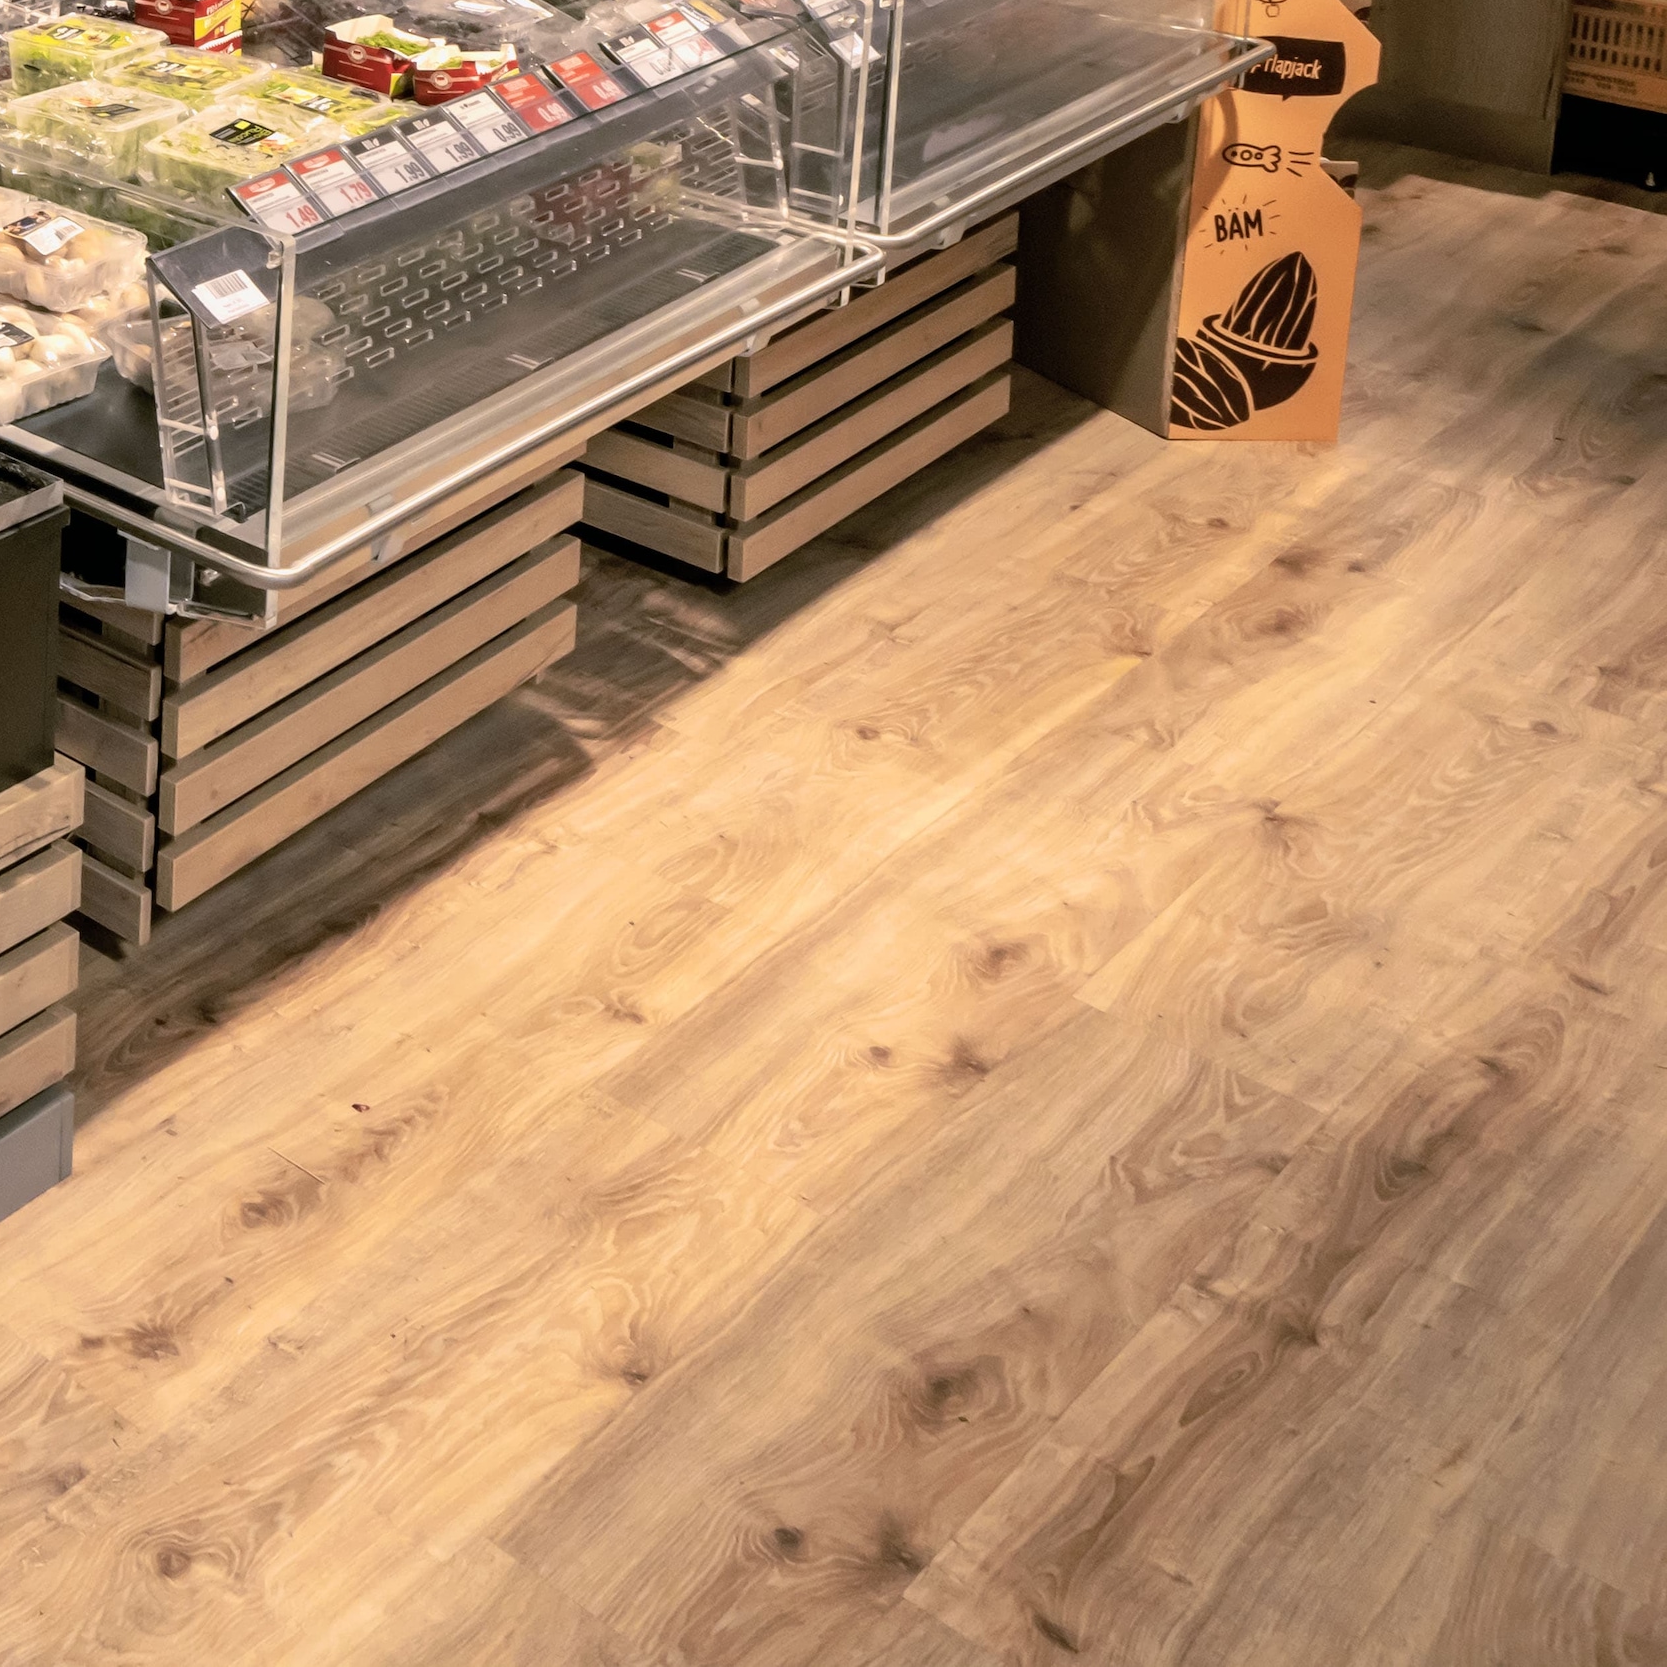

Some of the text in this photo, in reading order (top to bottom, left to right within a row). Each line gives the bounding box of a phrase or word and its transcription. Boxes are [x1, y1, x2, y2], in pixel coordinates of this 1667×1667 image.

[493, 121, 521, 143] 0.99
[445, 141, 476, 163] 1.99
[395, 161, 426, 183] 1.99
[340, 181, 372, 203] 1.79
[286, 204, 318, 229] 1.49
[1214, 207, 1264, 243] BÄM
